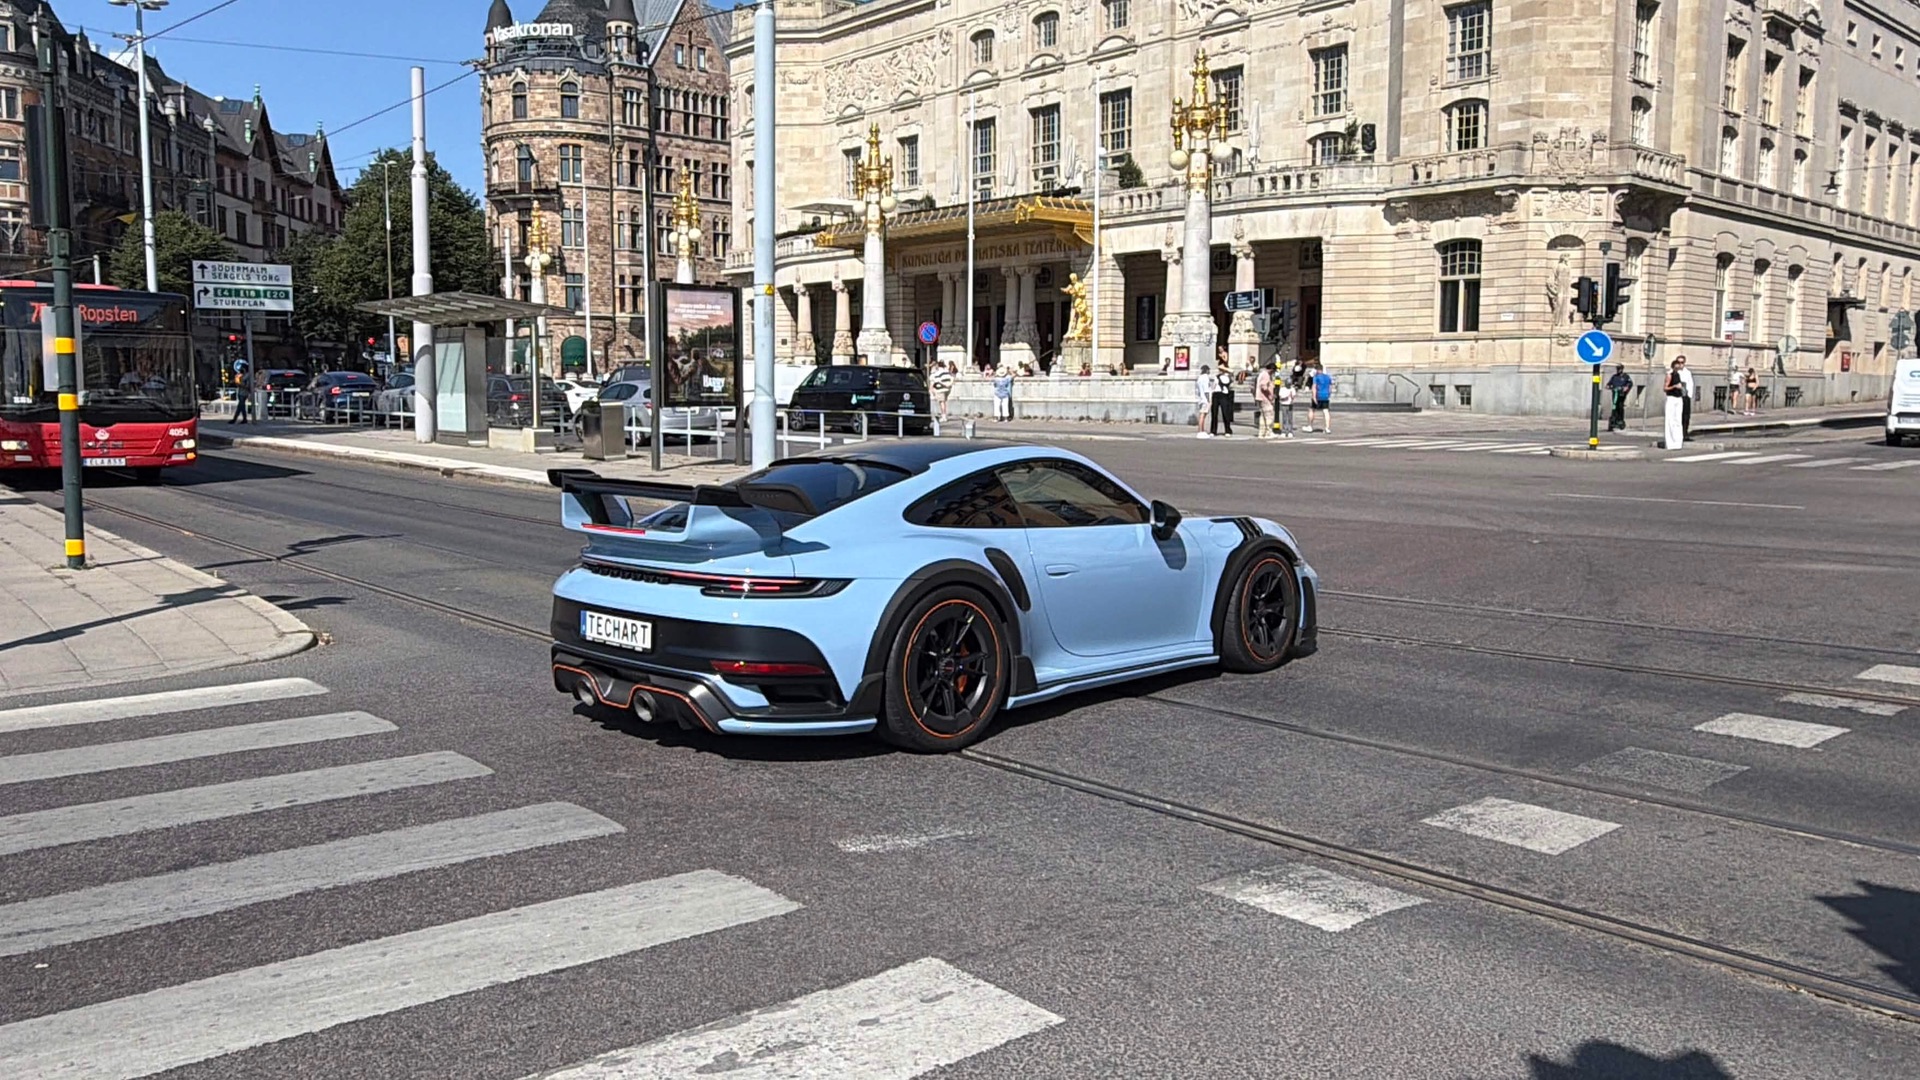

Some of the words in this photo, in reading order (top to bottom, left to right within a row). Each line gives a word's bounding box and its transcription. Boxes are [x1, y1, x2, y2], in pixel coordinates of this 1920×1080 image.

[493, 20, 574, 42] Vasakronan
[211, 264, 268, 274] SÖDERMALM
[211, 272, 252, 281] SERGELS
[256, 274, 280, 282] TORG
[217, 289, 230, 297] E4
[213, 299, 266, 307] STUREPLAN
[78, 304, 137, 325] Ropsten
[589, 614, 648, 645] TECHART
